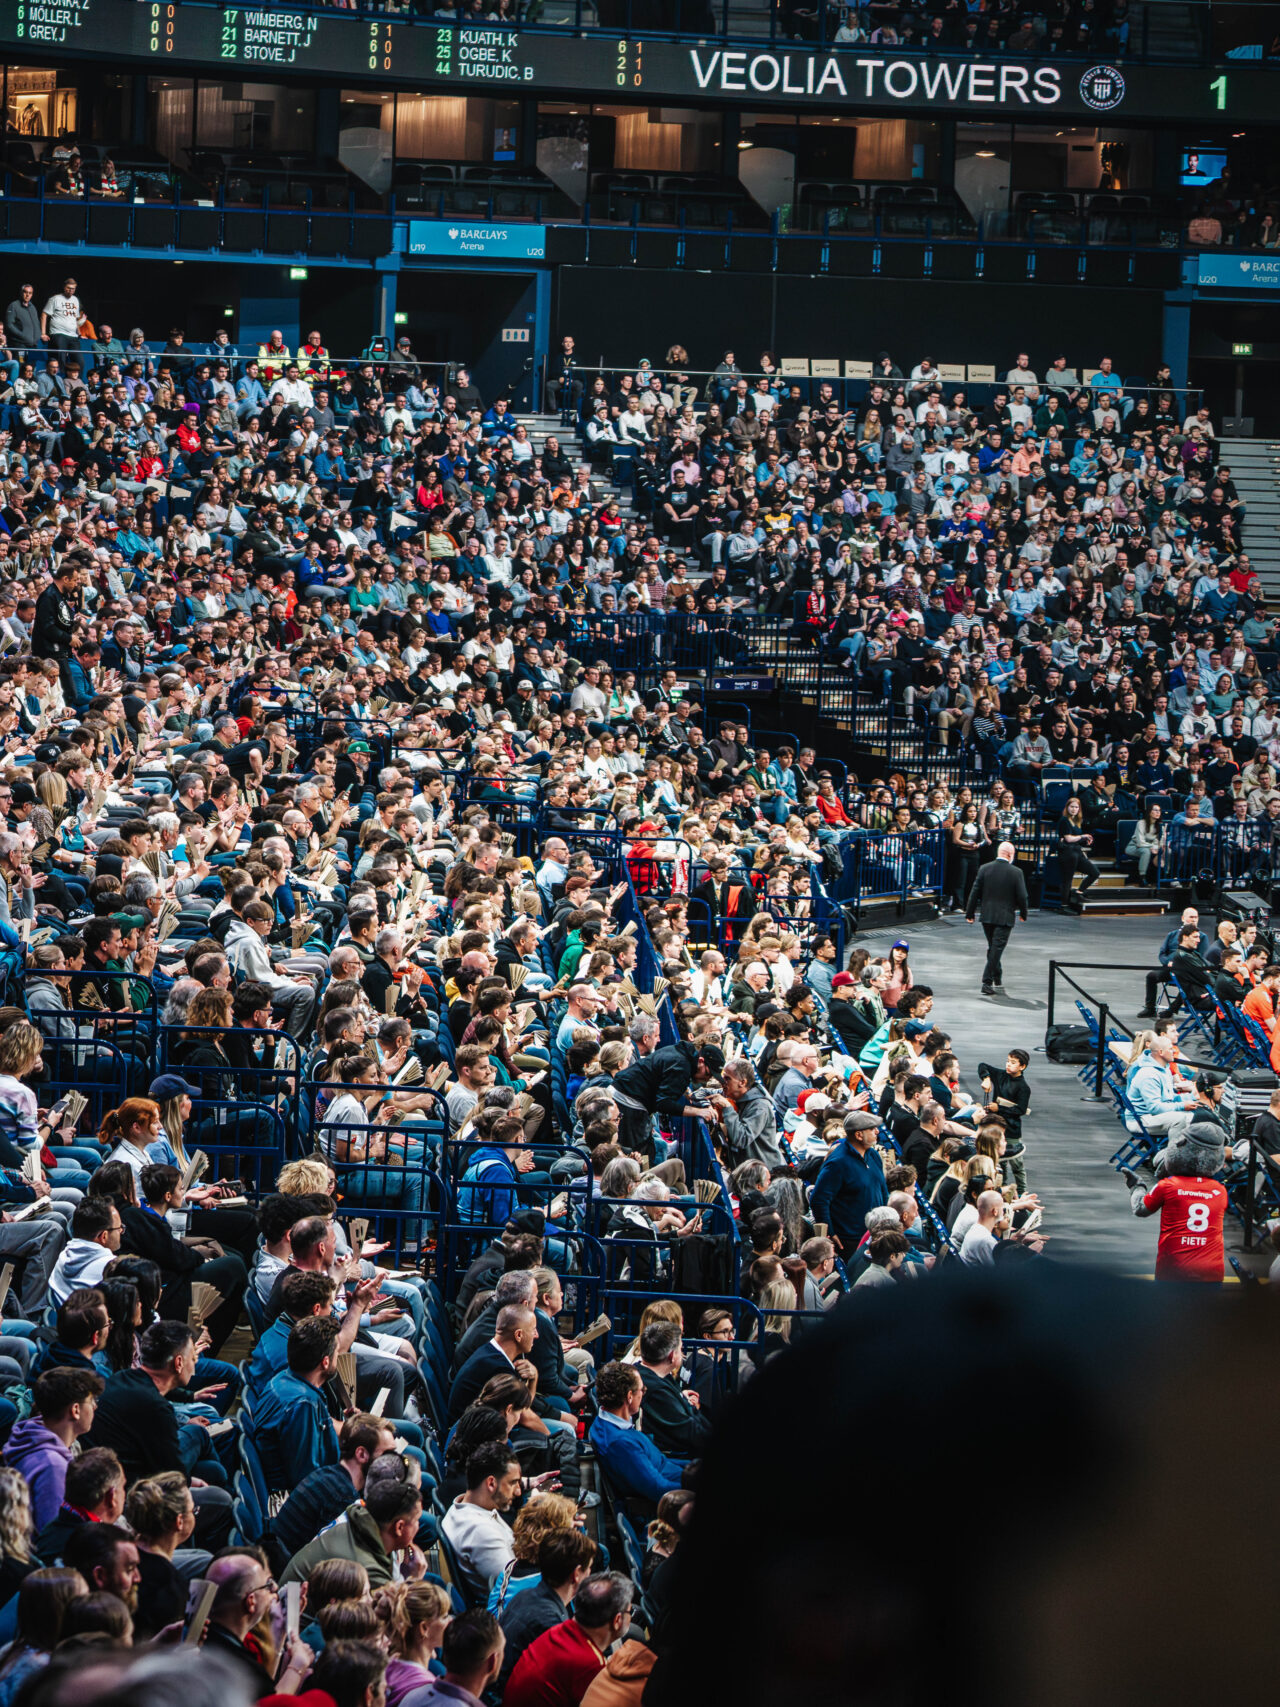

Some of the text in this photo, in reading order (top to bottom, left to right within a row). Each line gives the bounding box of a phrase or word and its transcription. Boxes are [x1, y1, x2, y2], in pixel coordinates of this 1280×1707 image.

[18, 6, 24, 20] 6
[74, 12, 82, 26] L
[151, 21, 159, 34] 0
[167, 22, 174, 34] 0
[152, 4, 159, 17] 0
[168, 5, 174, 18] 0
[223, 10, 238, 24] 17
[307, 17, 317, 31] N
[370, 23, 378, 36] 5
[386, 24, 392, 37] 1
[17, 23, 24, 37] 8
[59, 28, 66, 42] J
[151, 38, 158, 51] 0
[166, 39, 173, 51] 0
[222, 27, 237, 41] 21
[303, 34, 311, 47] J
[370, 39, 378, 52] 6
[384, 41, 392, 53] 0
[437, 29, 452, 43] 23
[508, 33, 519, 47] K
[618, 41, 627, 54] 6
[636, 42, 642, 54] 1
[221, 44, 237, 58] 22
[288, 49, 296, 62] J
[369, 56, 377, 69] 0
[384, 57, 391, 70] 0
[436, 45, 451, 59] 25
[502, 49, 512, 63] K
[617, 56, 627, 69] 2
[635, 58, 642, 70] 1
[435, 62, 450, 75] 44
[524, 67, 534, 81] B
[617, 72, 625, 86] 0
[634, 74, 642, 87] 0
[690, 50, 847, 96] VEOLIA
[856, 59, 1062, 104] TOWERS
[1210, 76, 1228, 110] 1
[460, 229, 508, 240] BARCLAYS
[460, 242, 485, 251] Arena
[410, 243, 426, 252] U19
[527, 248, 544, 256] U20
[1199, 275, 1217, 284] U20
[1252, 274, 1278, 283] Arena
[1177, 1189, 1213, 1199] Eurowings
[1186, 1203, 1210, 1233] 8
[1181, 1237, 1207, 1246] FIETE
